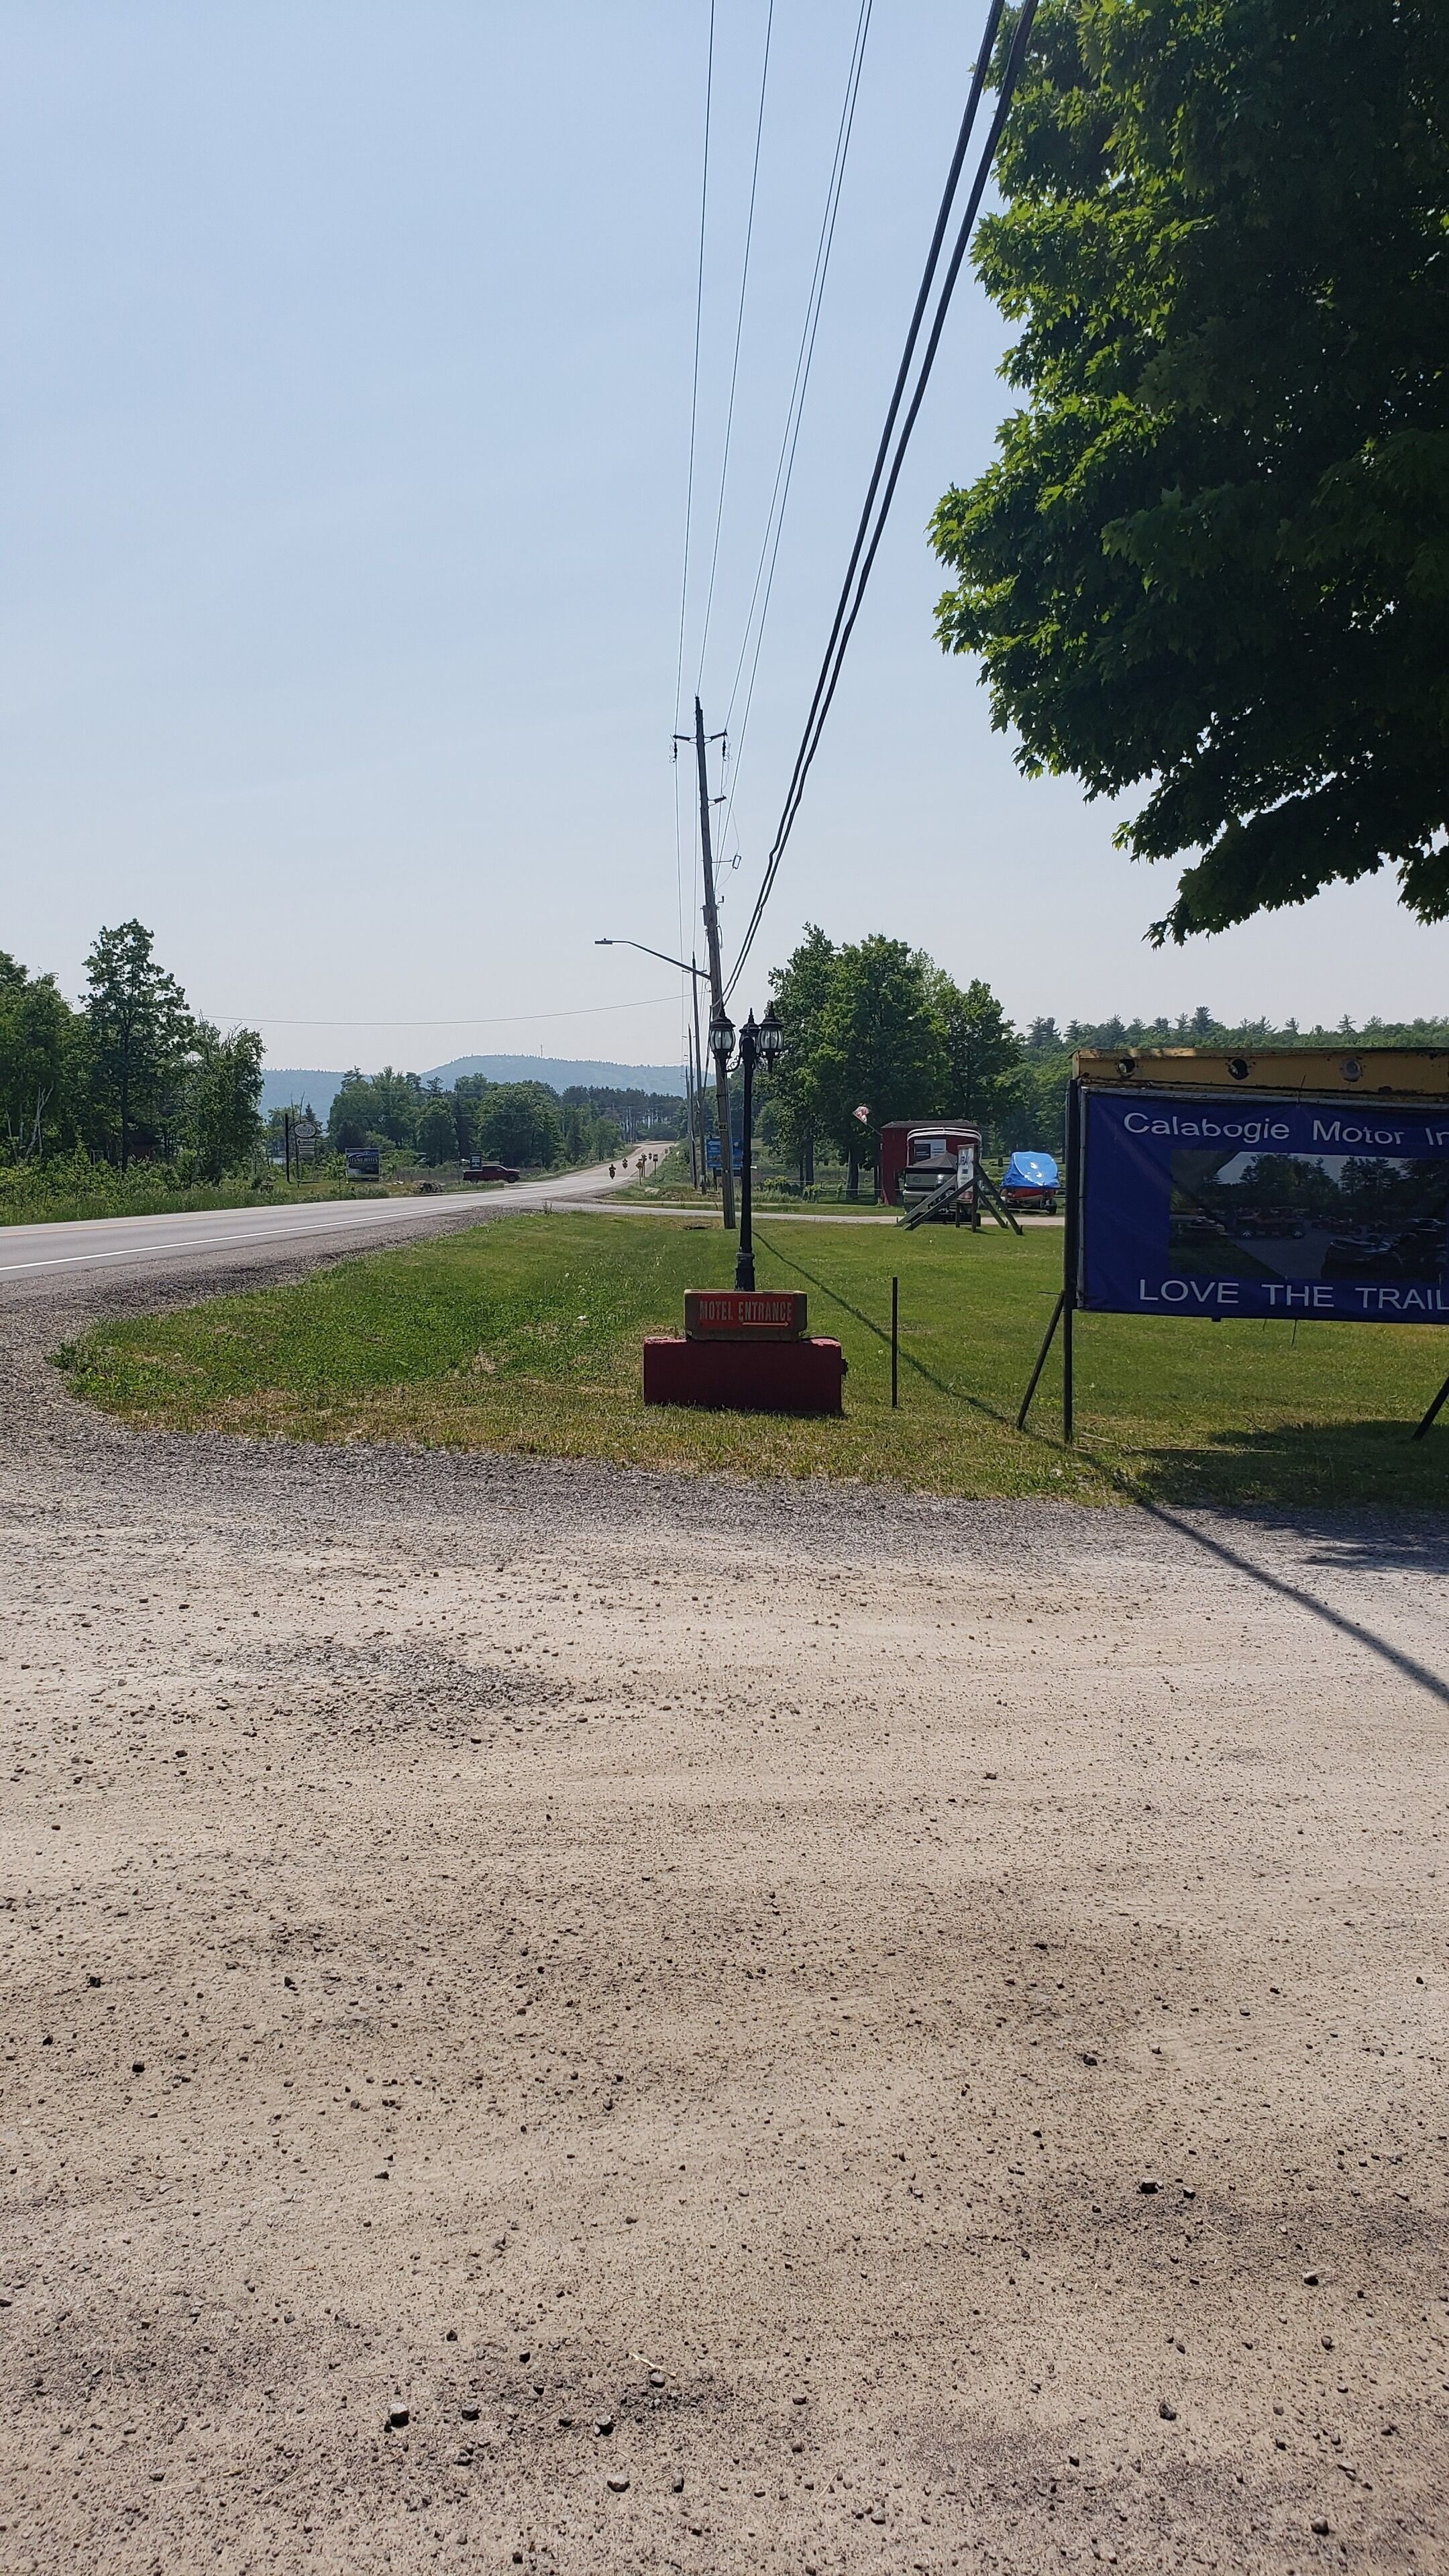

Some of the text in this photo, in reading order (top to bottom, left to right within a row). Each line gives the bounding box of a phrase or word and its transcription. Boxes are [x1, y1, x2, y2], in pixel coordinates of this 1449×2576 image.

[1124, 1112, 1289, 1143] Calabogie
[1312, 1120, 1405, 1144] Motor
[1140, 1279, 1449, 1310] LOVE THE TRAIL
[700, 1301, 792, 1321] MOTEL ENTRANCE
